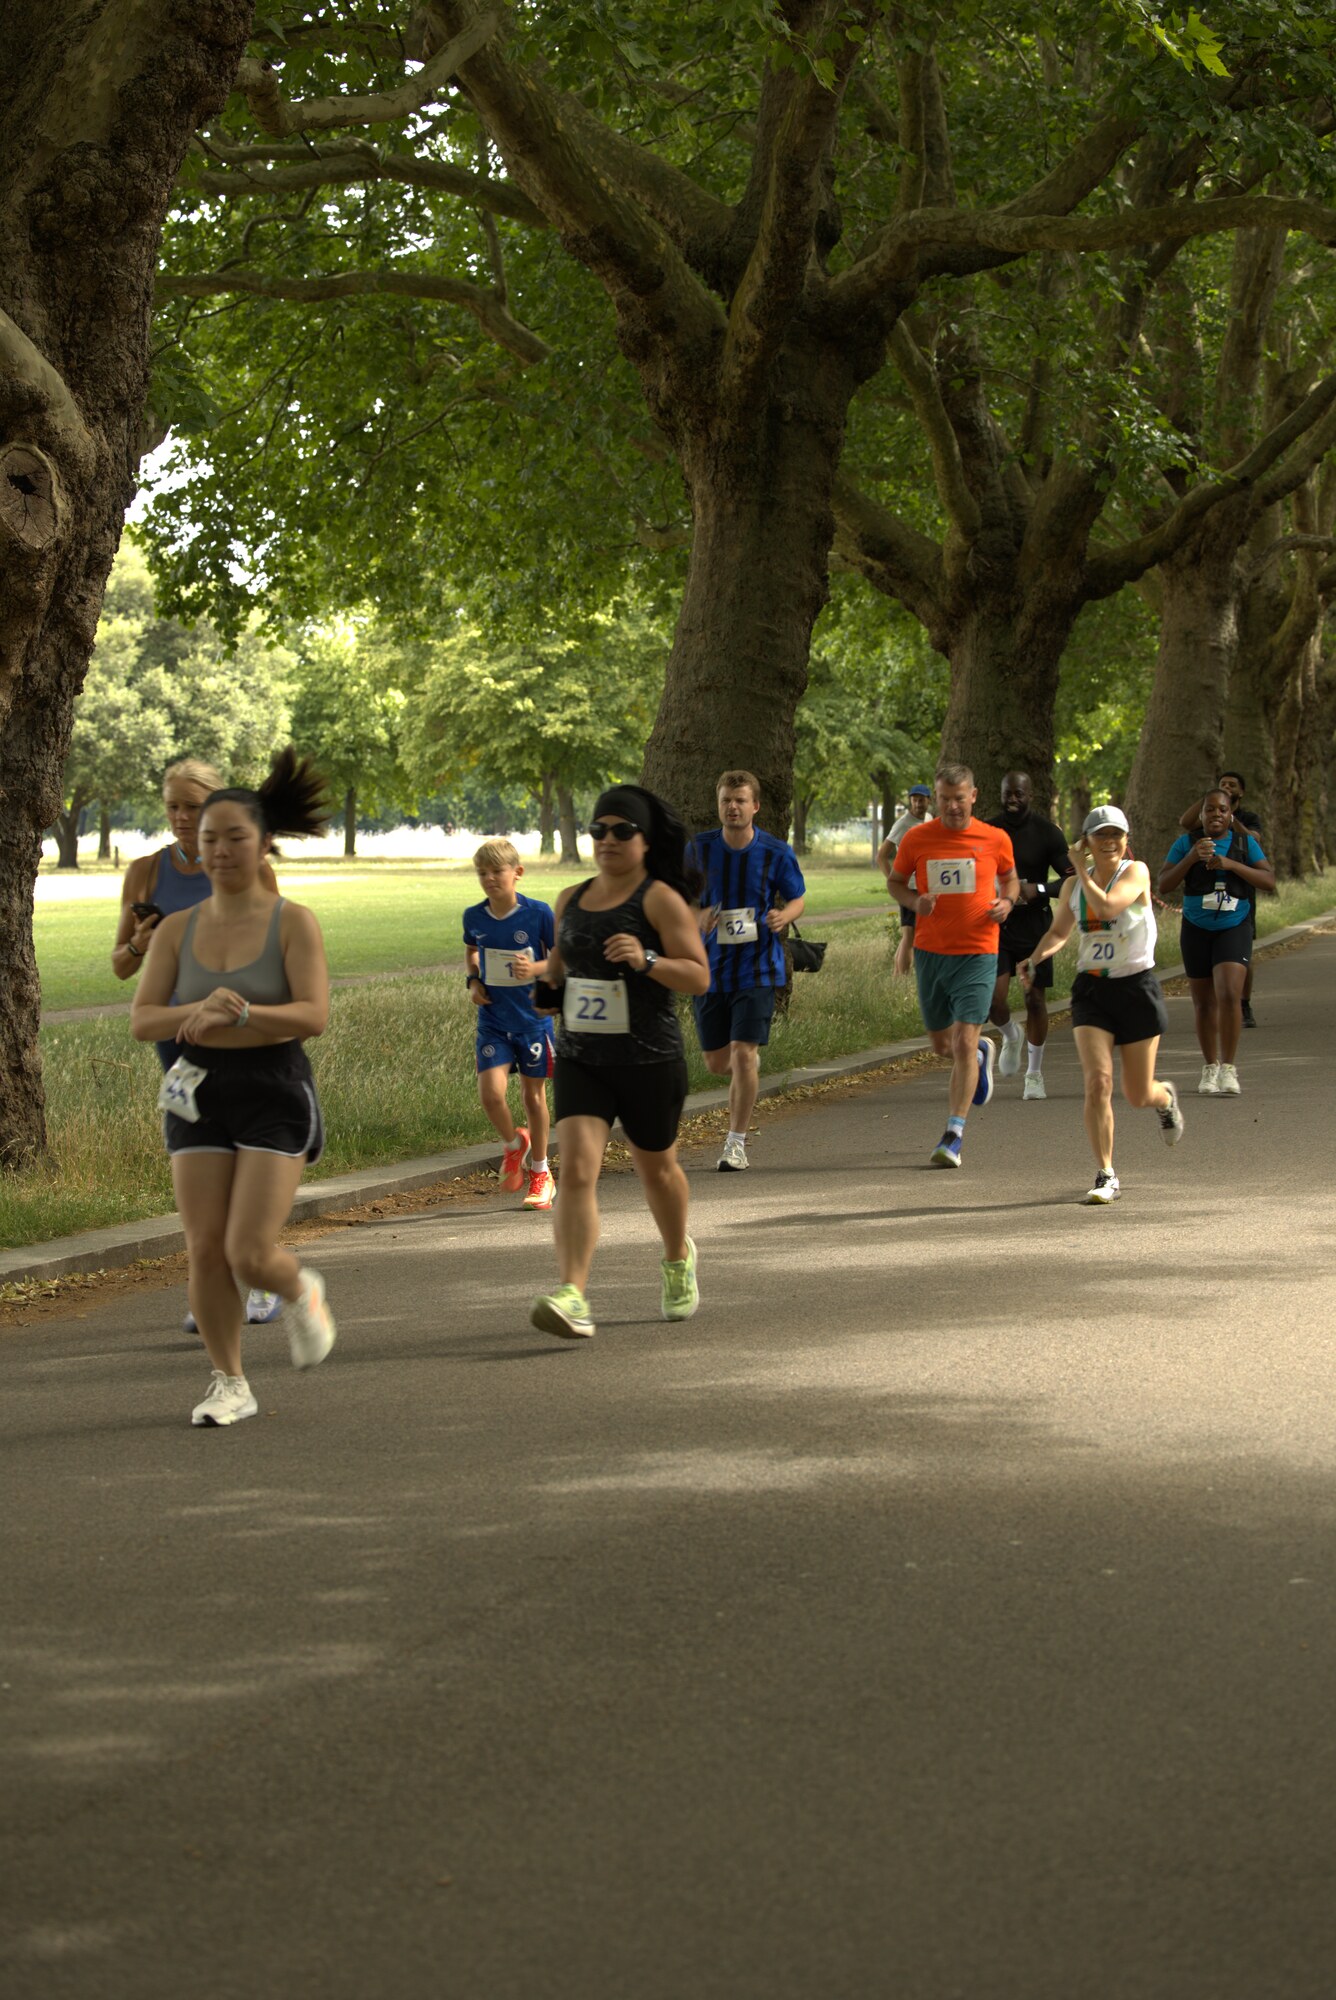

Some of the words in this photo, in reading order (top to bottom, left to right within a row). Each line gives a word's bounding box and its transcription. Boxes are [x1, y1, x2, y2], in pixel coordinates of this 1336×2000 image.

[940, 870, 961, 886] 61
[726, 920, 746, 936] 62
[1092, 943, 1115, 961] 20
[576, 996, 609, 1020] 22
[530, 1042, 543, 1061] 9
